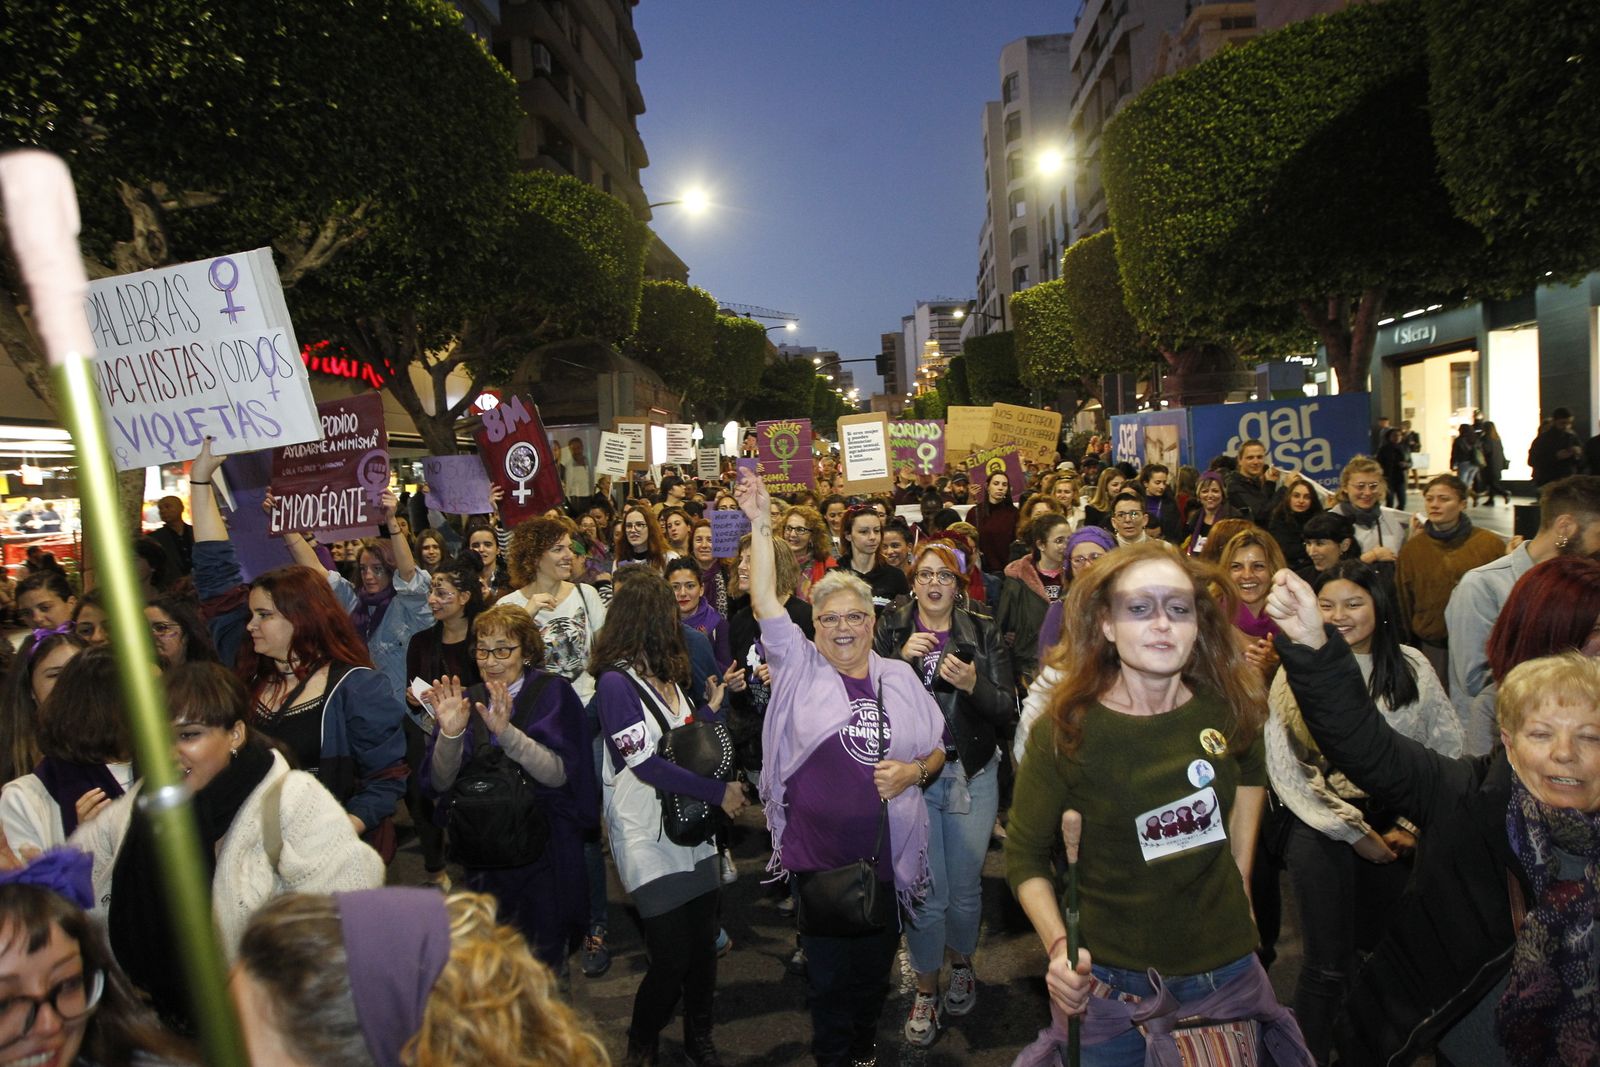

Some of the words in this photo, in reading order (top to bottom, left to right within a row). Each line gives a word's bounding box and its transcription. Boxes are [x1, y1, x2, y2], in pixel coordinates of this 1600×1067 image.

[86, 273, 200, 348] PALABRAS
[113, 399, 282, 459] VIOLETAS
[482, 394, 531, 443] 8M
[763, 421, 802, 438] UNIDAS
[282, 440, 329, 459] AYUDARME
[763, 473, 790, 482] SOMOS
[271, 485, 368, 532] EMPODÉRATE
